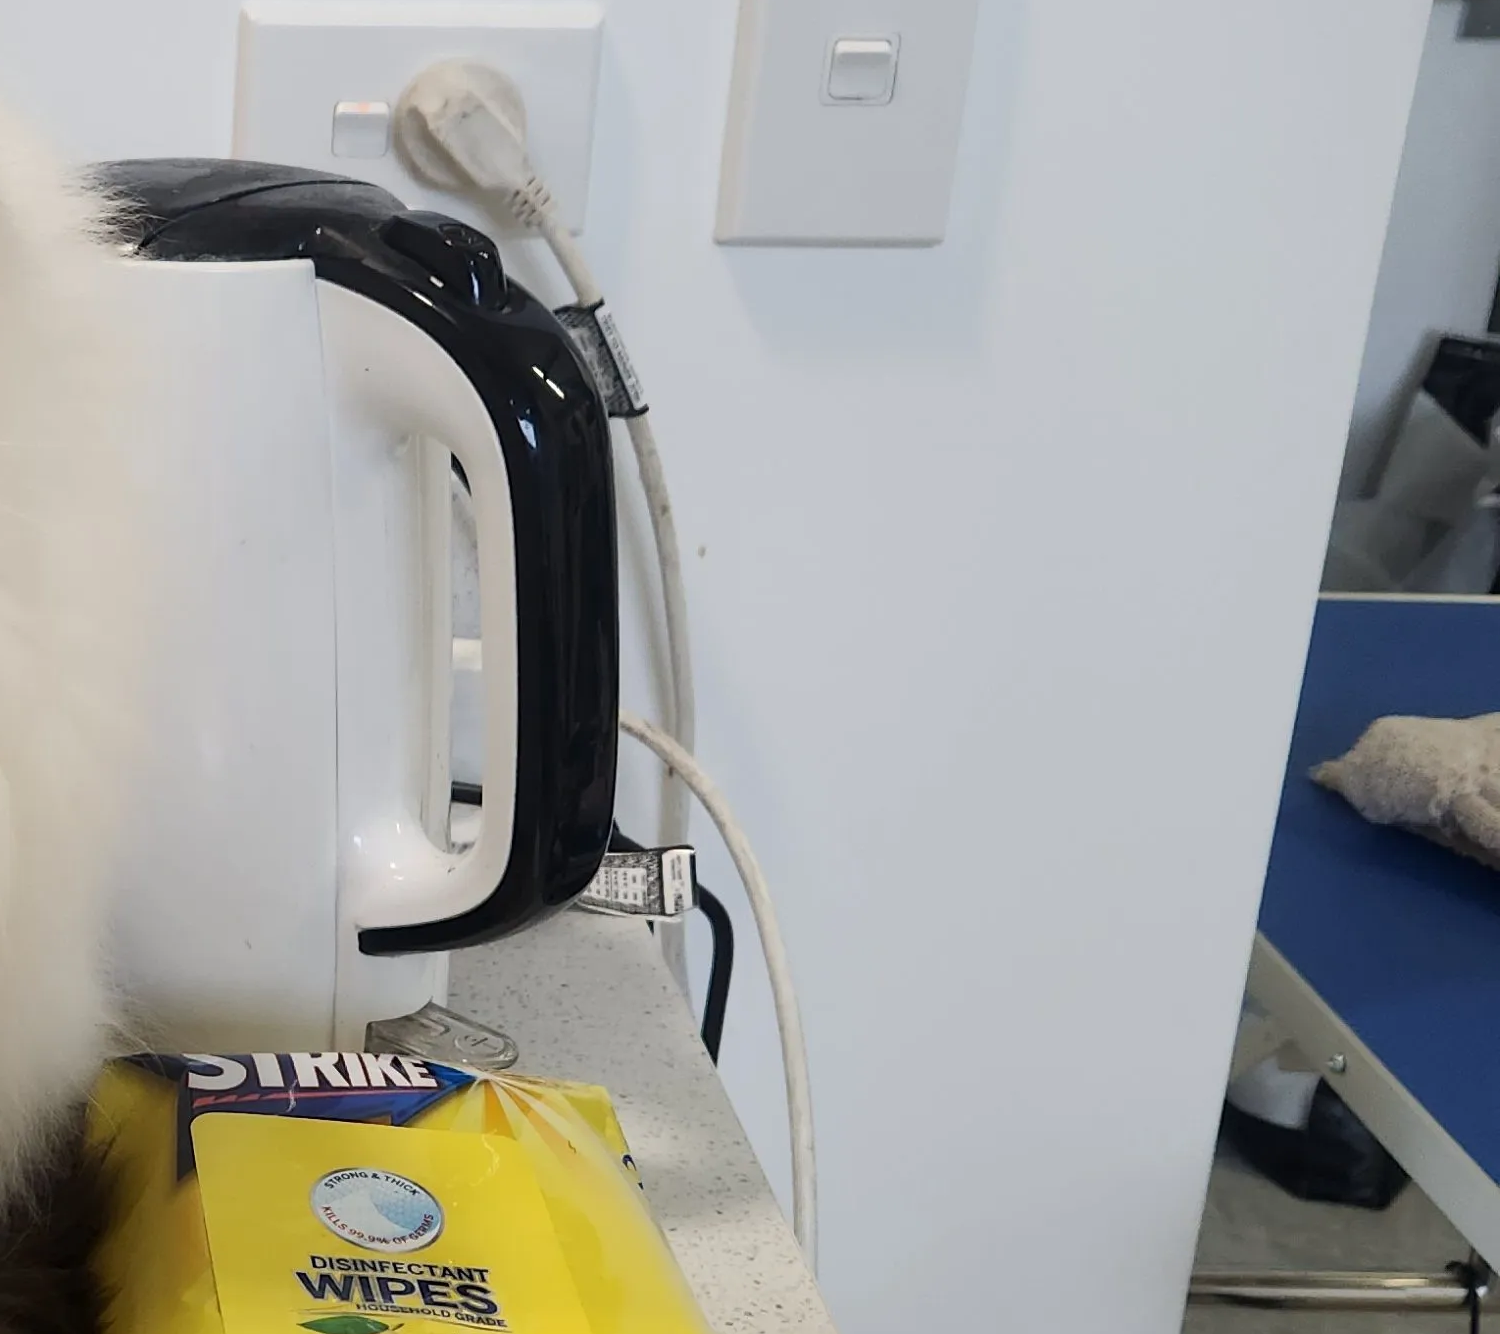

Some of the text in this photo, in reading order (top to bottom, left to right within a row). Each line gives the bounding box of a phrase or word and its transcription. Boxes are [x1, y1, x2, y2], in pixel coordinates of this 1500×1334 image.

[186, 1053, 438, 1090] STRIKE
[324, 1171, 421, 1196] STRONG & THICK
[322, 1205, 435, 1245] KILLS 99.9% OF GERMS
[310, 1255, 489, 1283] DISINFECTANT
[296, 1271, 498, 1315] WIPES
[356, 1303, 508, 1328] HOUSEHOLD GRADE
